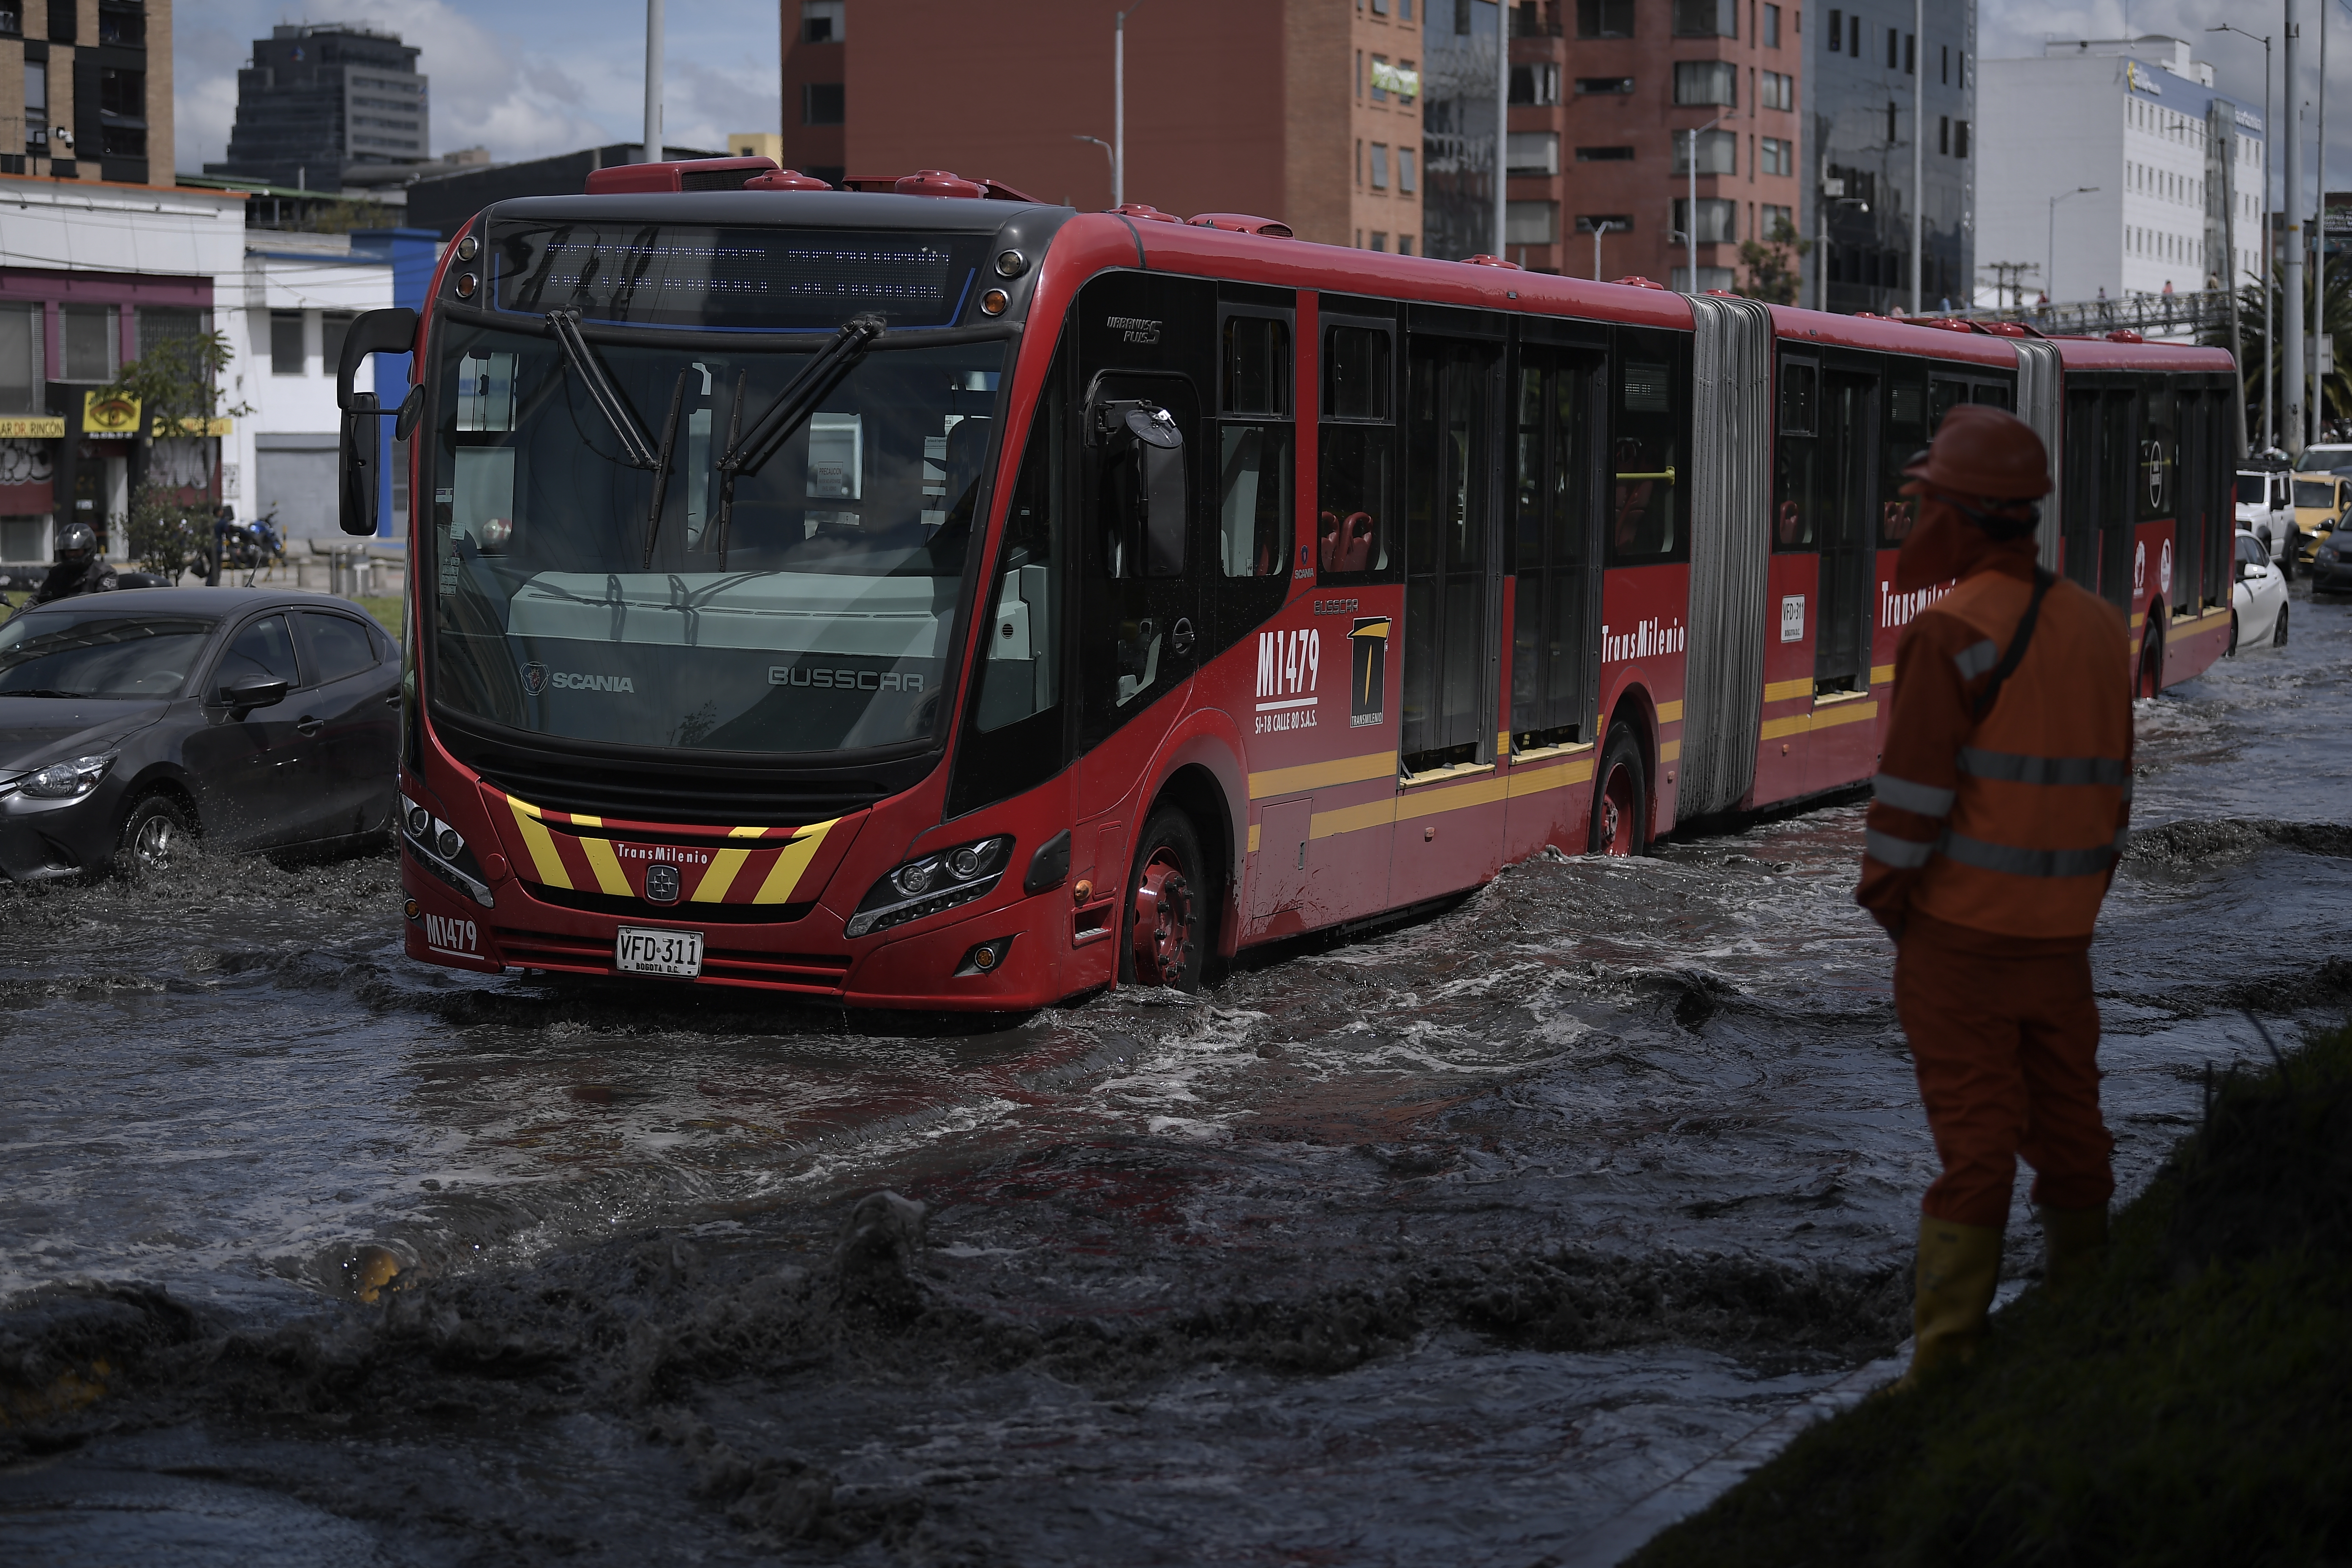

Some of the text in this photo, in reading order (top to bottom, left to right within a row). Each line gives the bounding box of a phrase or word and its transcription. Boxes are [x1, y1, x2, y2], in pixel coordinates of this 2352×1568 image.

[819, 466, 841, 475] PRECAUCIÓN
[1295, 568, 1314, 579] SCANIA
[1314, 598, 1358, 615] BUSSCAR
[1601, 616, 1684, 663] TransMilenio
[1255, 629, 1320, 697] M1479
[552, 672, 634, 693] SCANIA
[768, 666, 924, 692] BUSSCAR
[1255, 709, 1317, 734] SI-18 CALLE 80 S.A.S.
[1351, 712, 1382, 726] TRANSMILENIO
[618, 844, 708, 864] TransMilenio
[426, 913, 477, 951] M1479
[636, 962, 663, 972] BOGOTA
